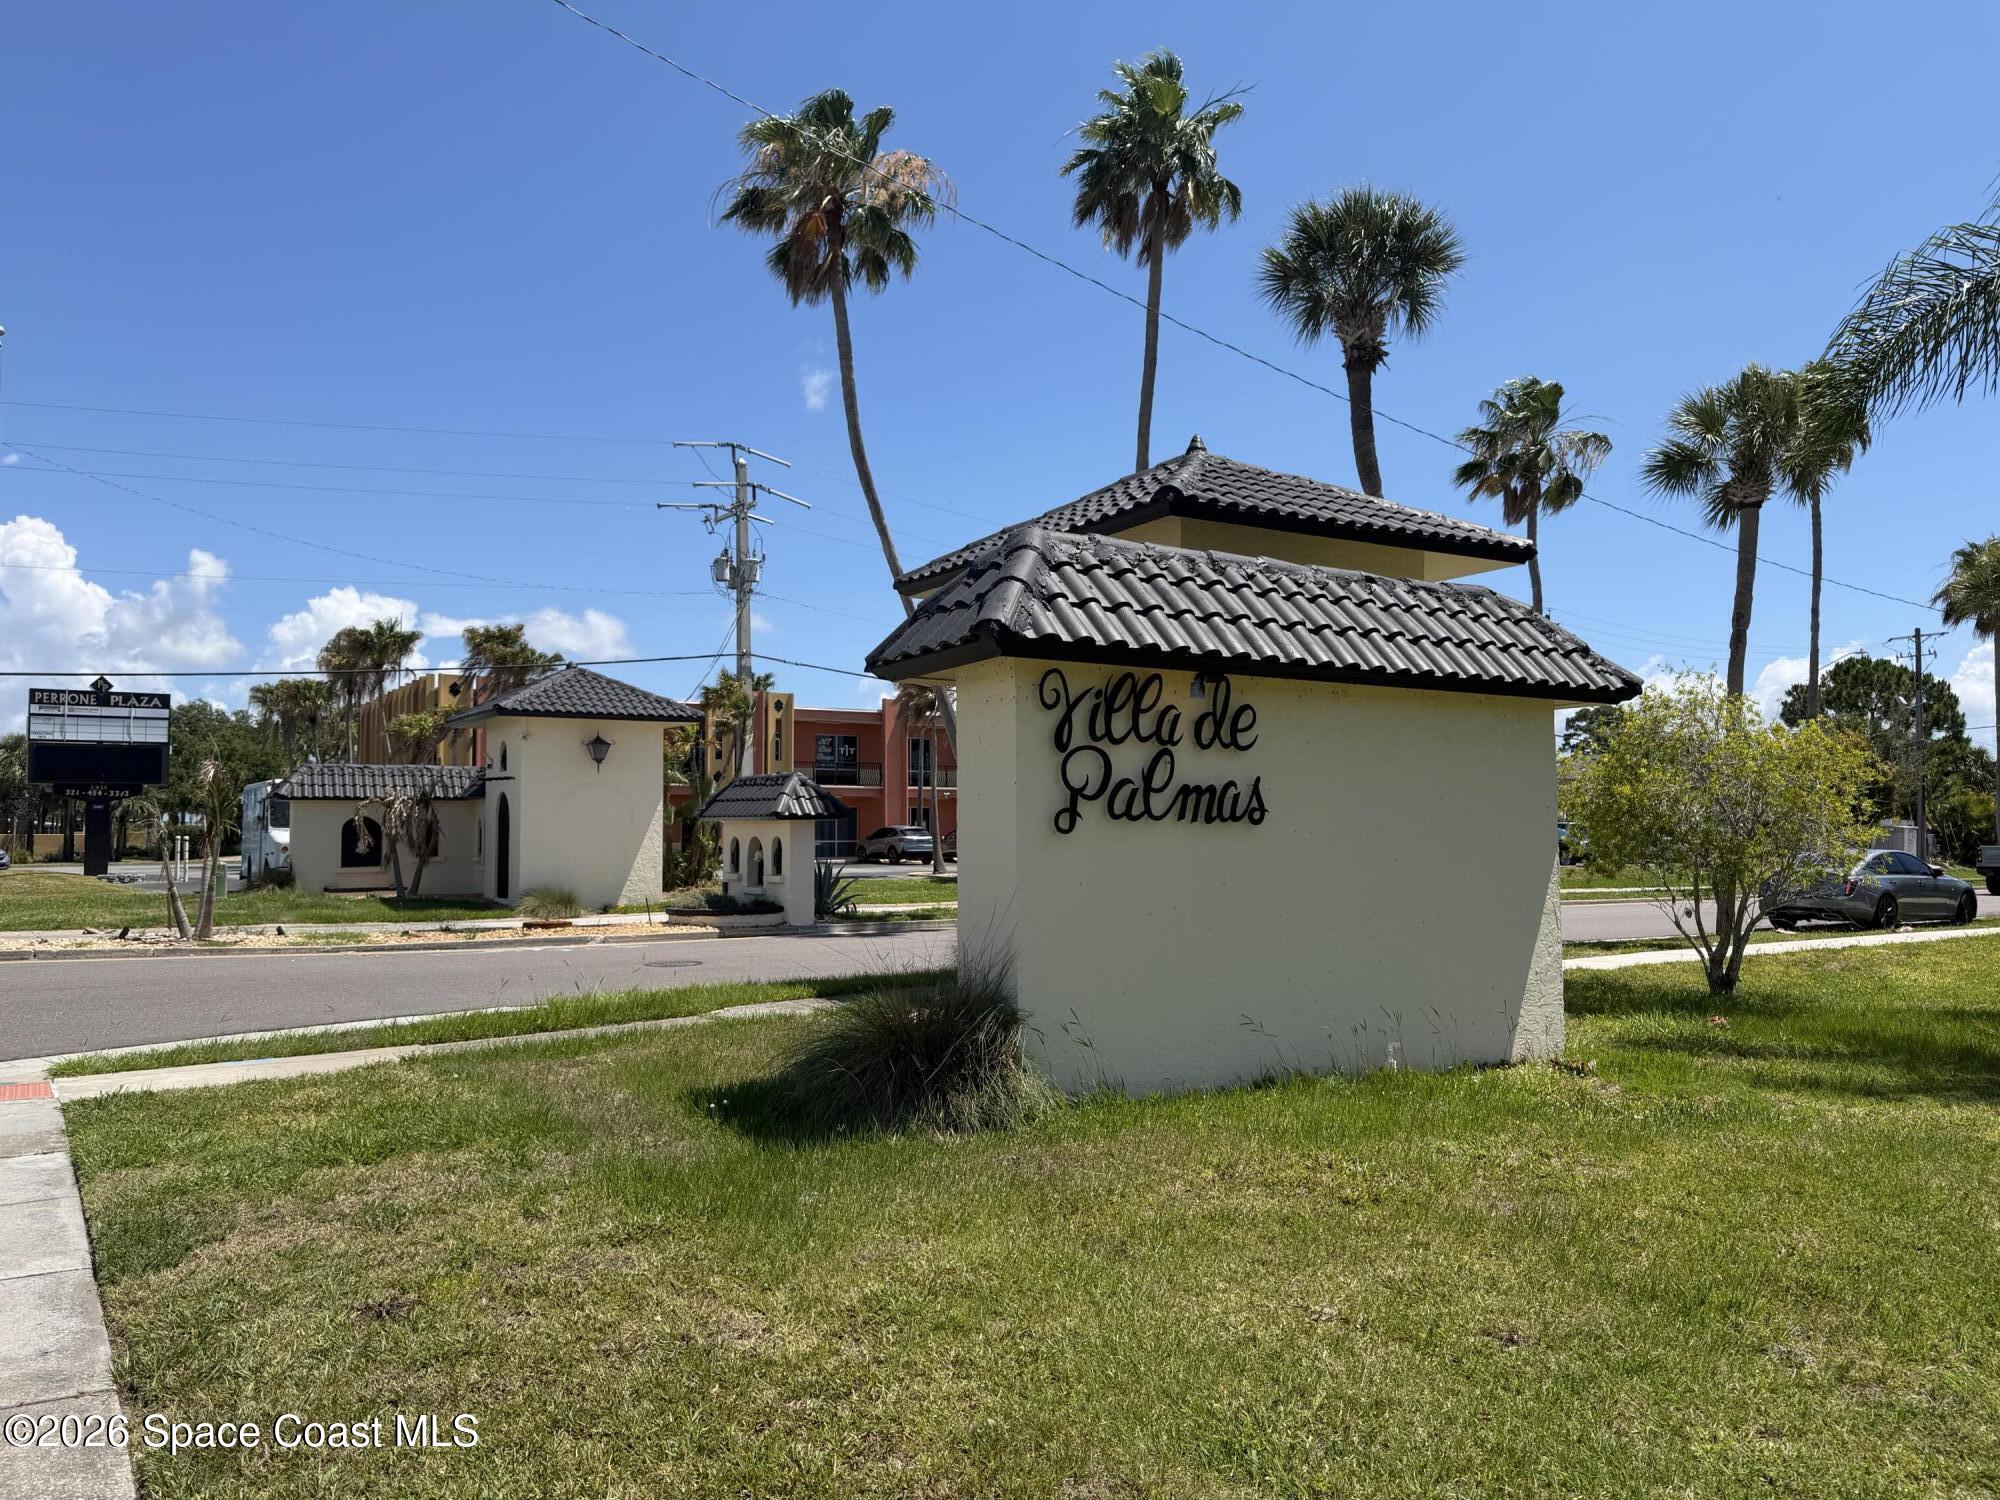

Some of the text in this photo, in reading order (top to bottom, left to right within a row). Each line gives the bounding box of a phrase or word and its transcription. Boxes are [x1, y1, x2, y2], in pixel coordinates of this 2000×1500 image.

[34, 691, 163, 708] PERRONE PLAZA
[1039, 668, 1259, 753] Villa de
[1054, 745, 1269, 834] Palmas
